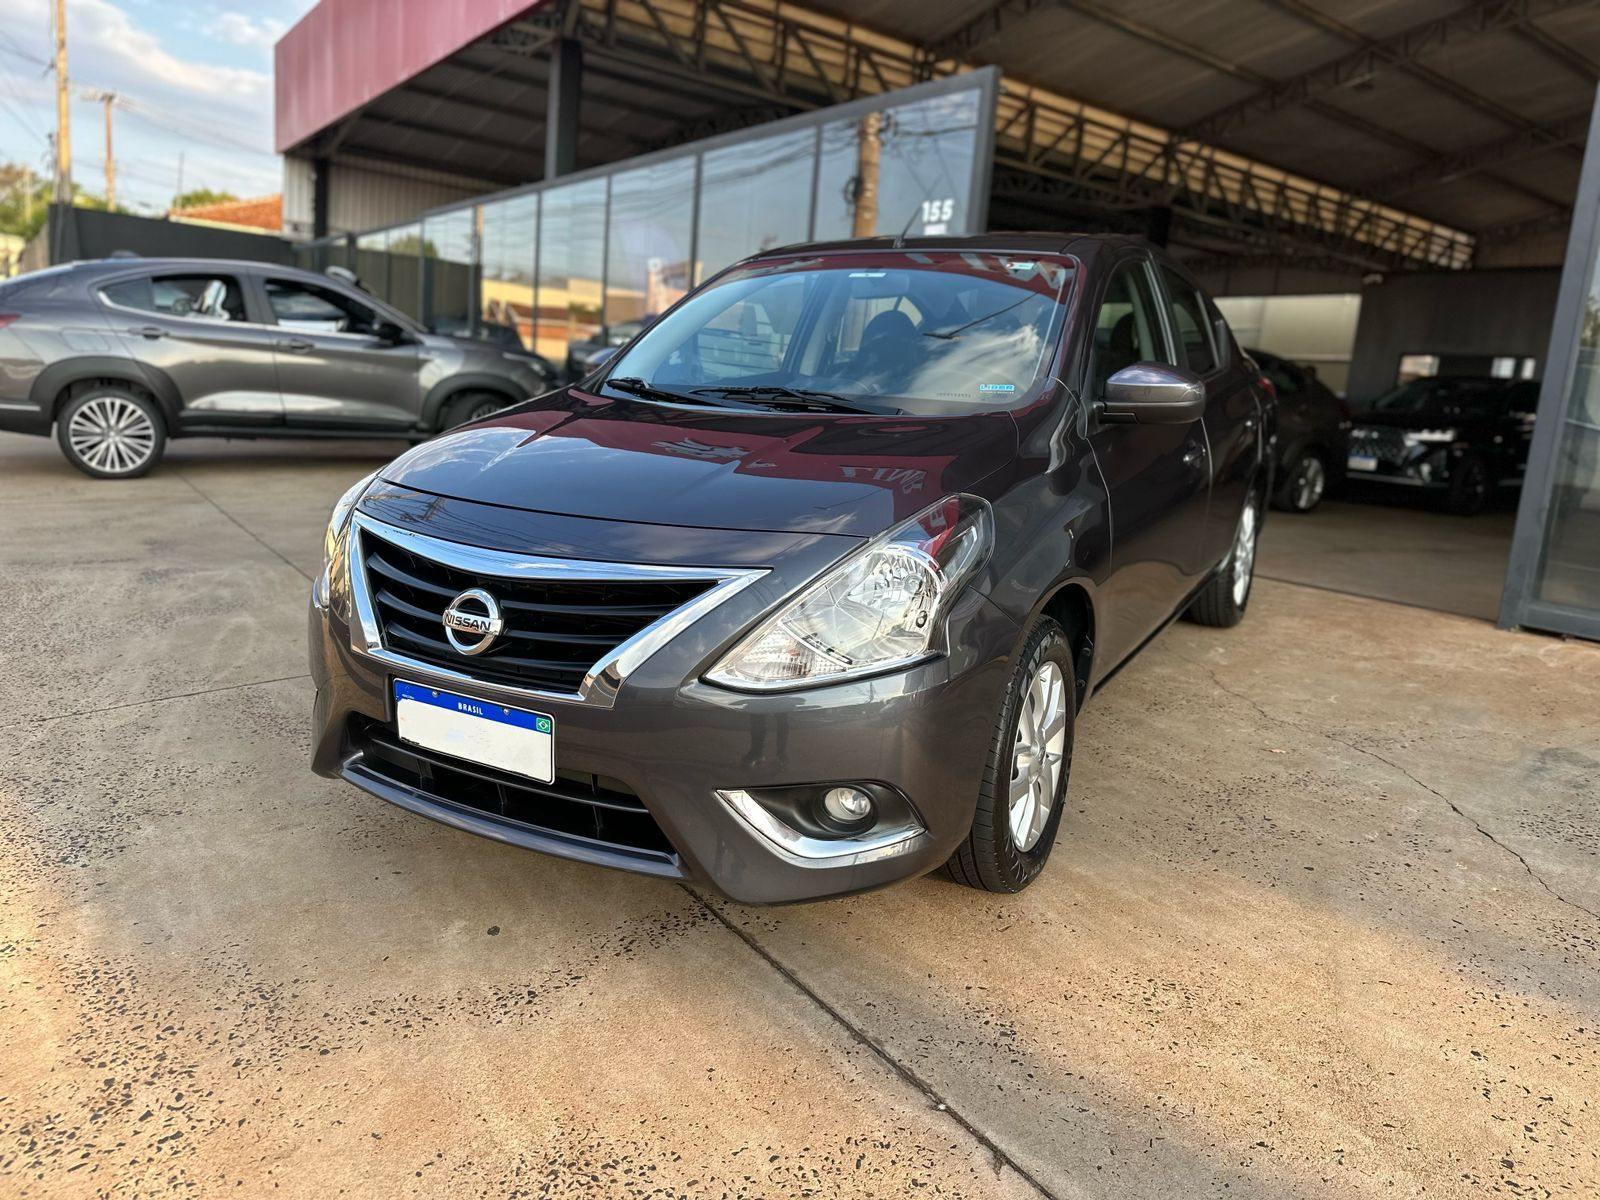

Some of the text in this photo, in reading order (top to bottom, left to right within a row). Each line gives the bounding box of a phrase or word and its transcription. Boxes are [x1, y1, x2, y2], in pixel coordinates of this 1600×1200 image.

[922, 199, 954, 223] 155
[445, 613, 491, 631] NISSAN
[457, 702, 484, 716] BRASIL
